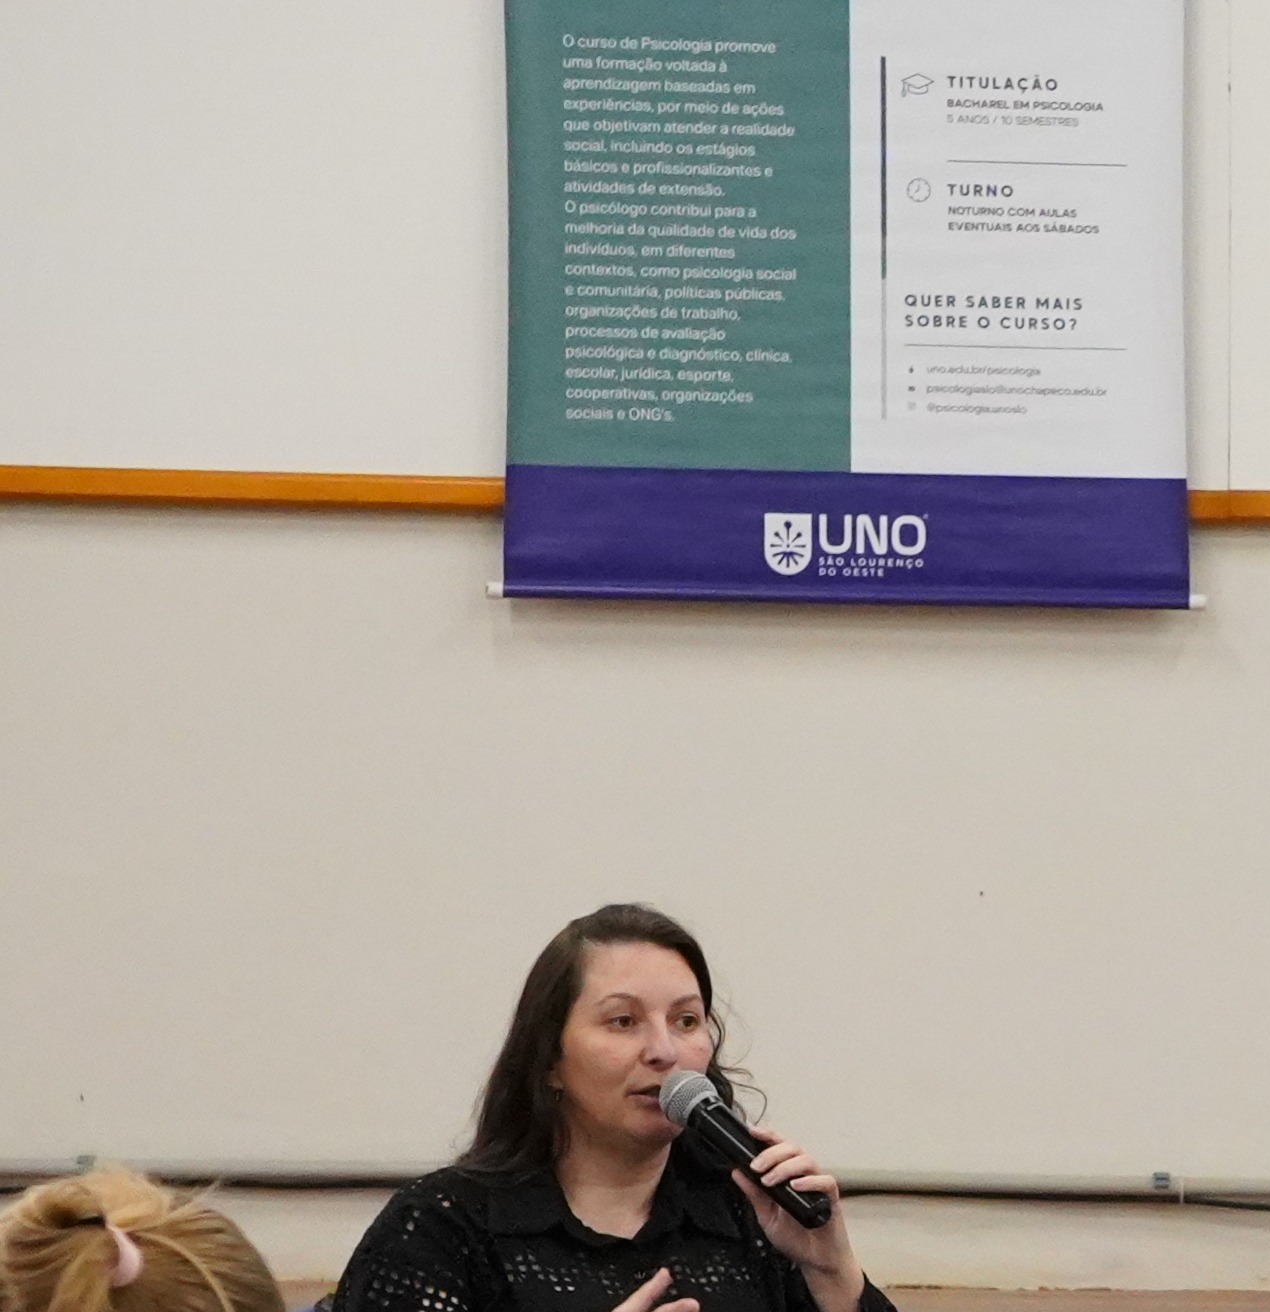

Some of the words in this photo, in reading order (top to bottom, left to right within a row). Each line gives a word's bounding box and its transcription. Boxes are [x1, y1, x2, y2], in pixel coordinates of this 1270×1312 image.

[562, 33, 575, 48] O
[577, 35, 616, 49] curso
[620, 35, 638, 49] de
[641, 35, 712, 54] Psicologia
[715, 40, 776, 54] promove
[562, 57, 593, 69] uma
[595, 56, 662, 73] formação
[665, 59, 716, 73] voltada
[719, 60, 727, 73] à
[563, 77, 661, 94] aprendizagem
[664, 79, 731, 94] baseadas
[734, 83, 756, 94] em
[947, 75, 1058, 93] TITULAÇÃO
[657, 101, 681, 115] por
[684, 100, 718, 114] meio
[722, 101, 739, 115] de
[742, 101, 784, 118] ações
[947, 99, 1010, 109] BACHAREL
[1014, 100, 1030, 110] EM
[1033, 101, 1103, 111] PSICOLOGIA
[564, 120, 590, 134] que
[593, 118, 661, 136] objetivam
[664, 121, 717, 135] atender
[720, 124, 729, 135] a
[732, 122, 794, 137] realidade
[957, 115, 989, 124] ANOS
[1001, 116, 1012, 125] 10
[1016, 117, 1078, 126] SEMESTRES
[610, 140, 673, 154] incluindo
[676, 143, 693, 155] os
[696, 141, 756, 159] estágios
[564, 160, 618, 173] básicos
[622, 163, 630, 173] e
[633, 161, 761, 177] profissionalizantes
[765, 165, 773, 177] e
[564, 180, 635, 194] atividades
[638, 181, 656, 195] de
[947, 184, 1013, 197] TURNO
[565, 200, 576, 214] O
[579, 201, 647, 217] psicólogo
[651, 202, 712, 217] contribui
[714, 206, 745, 219] para
[748, 206, 757, 218] a
[949, 207, 1004, 216] NOTURNO
[1007, 208, 1035, 217] COM
[1039, 208, 1077, 217] AULAS
[565, 221, 624, 235] melhoria
[627, 223, 645, 235] da
[648, 223, 715, 239] qualidade
[718, 224, 736, 238] de
[738, 224, 767, 238] vida
[770, 225, 797, 240] dos
[949, 223, 1012, 232] EVENTUAIS
[1016, 223, 1039, 232] AOS
[1044, 223, 1099, 233] SÁBADOS
[641, 244, 663, 256] em
[667, 243, 735, 259] diferentes
[641, 266, 679, 278] como
[683, 265, 753, 282] psicologia
[756, 267, 796, 281] social
[565, 284, 574, 296] e
[664, 285, 722, 301] políticas
[905, 295, 956, 307] QUER
[966, 296, 1025, 309] SABER
[1036, 298, 1083, 310] MAIS
[565, 304, 658, 321] organizações
[660, 306, 678, 319] de
[905, 315, 967, 328] SOBRE
[978, 317, 990, 328] O
[1000, 317, 1077, 330] CURSO?
[565, 327, 638, 339] processos
[641, 326, 658, 339] de
[661, 327, 725, 343] avaliação
[566, 346, 644, 361] psicológica
[647, 349, 656, 360] e
[661, 388, 753, 404] organizações
[566, 407, 613, 420] sociais
[617, 410, 625, 421] e
[819, 513, 925, 555] UNO
[819, 557, 844, 567] SÃO
[850, 558, 924, 569] LOURENÇO
[819, 568, 835, 576] DO
[843, 568, 884, 577] OESTE
